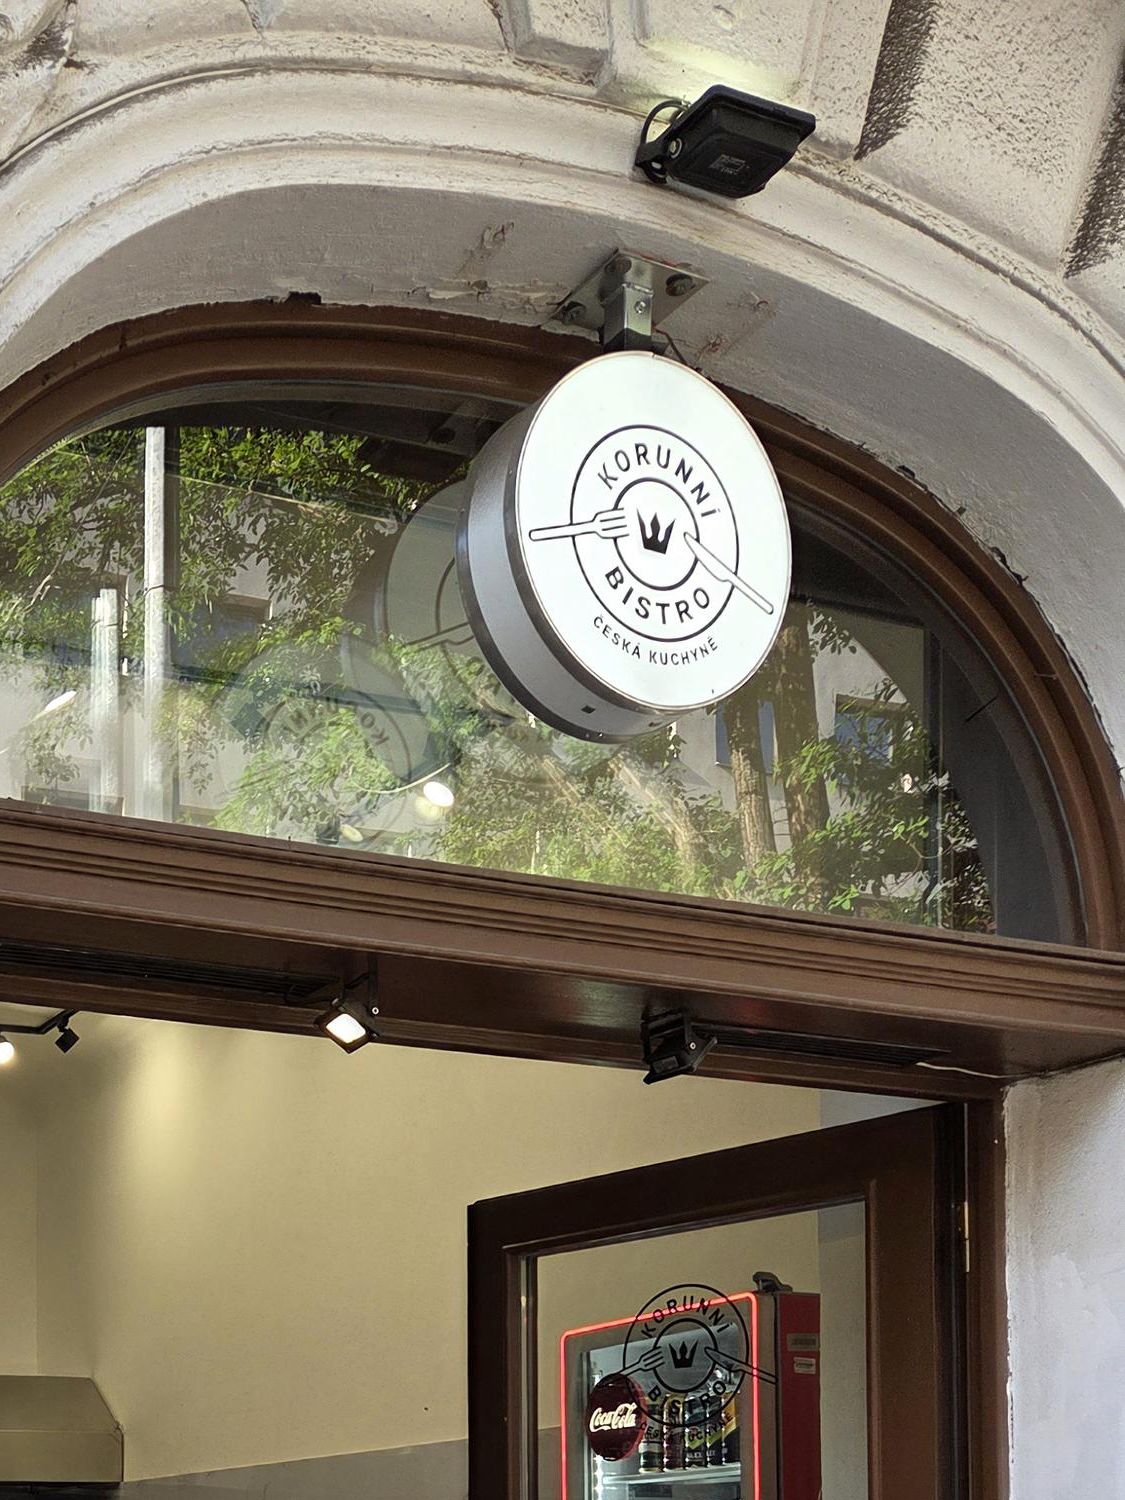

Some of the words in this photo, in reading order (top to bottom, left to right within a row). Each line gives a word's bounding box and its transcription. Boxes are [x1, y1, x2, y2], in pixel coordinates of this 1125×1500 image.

[598, 443, 721, 518] KORUNNÍ
[605, 566, 711, 625] BISTRO
[593, 613, 641, 660] ČESKÁ
[649, 635, 718, 666] KUCHYNĚ
[647, 1381, 727, 1415] BISTRO
